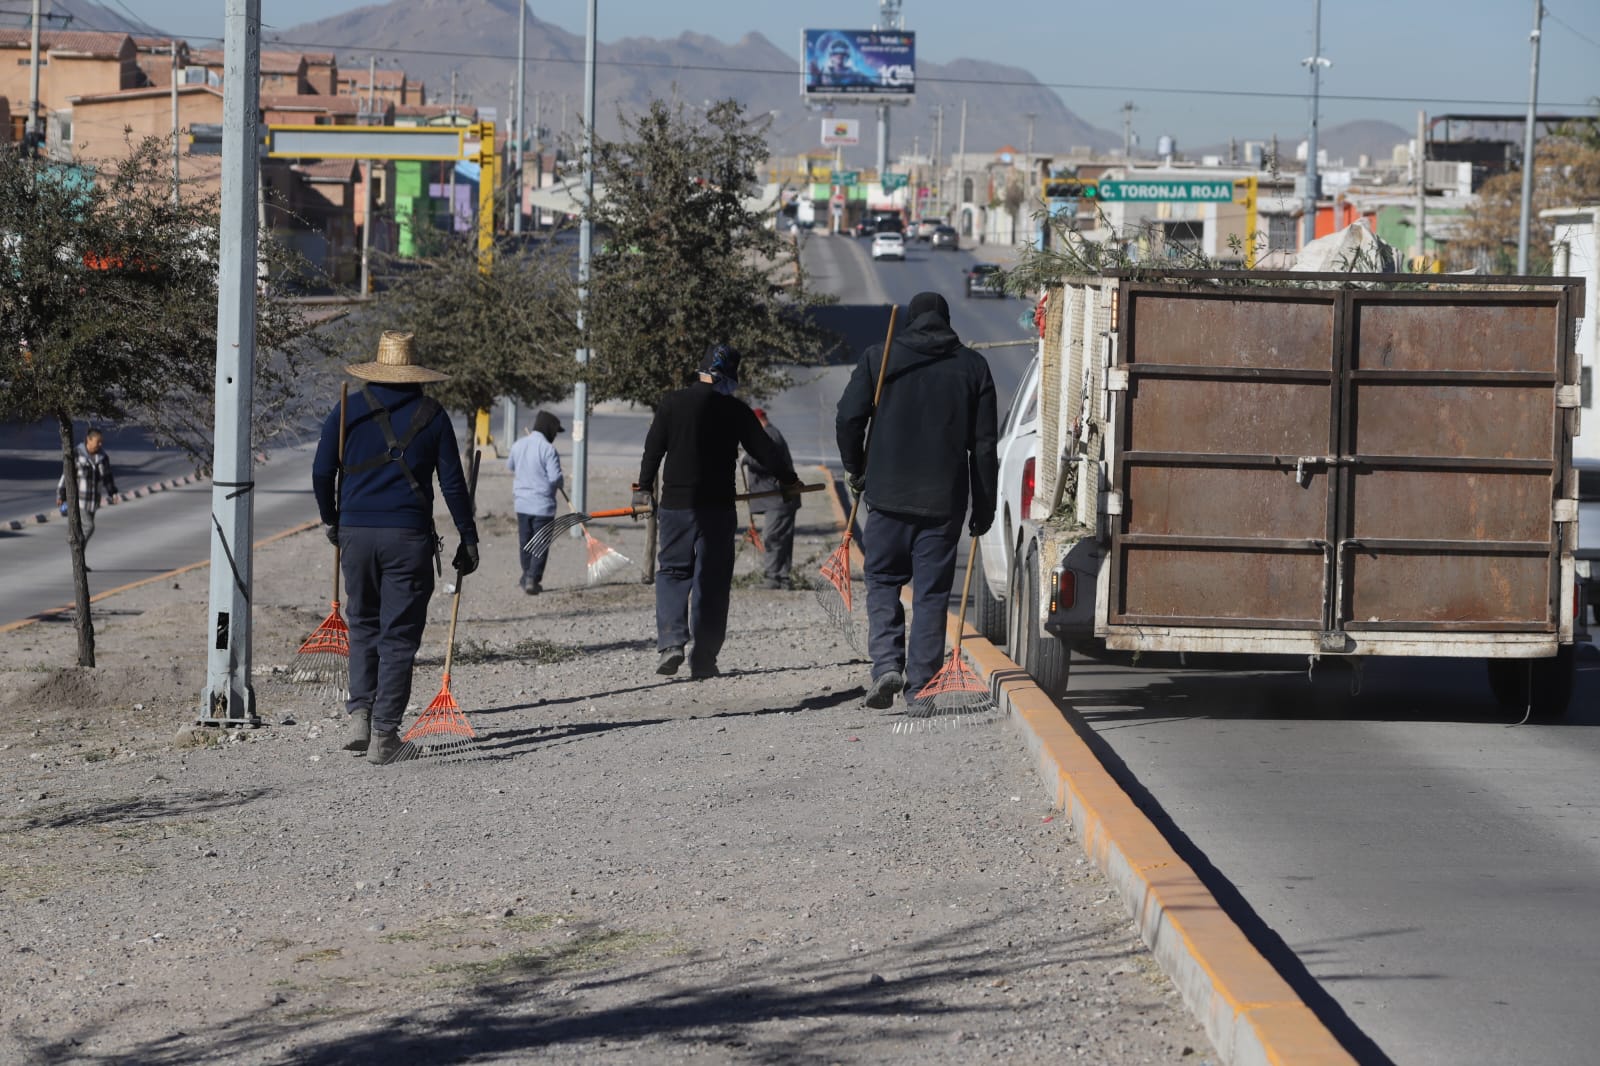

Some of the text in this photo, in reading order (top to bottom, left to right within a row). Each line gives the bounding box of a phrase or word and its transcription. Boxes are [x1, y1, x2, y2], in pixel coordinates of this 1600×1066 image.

[1101, 185, 1230, 198] C. TORONJA ROJA
